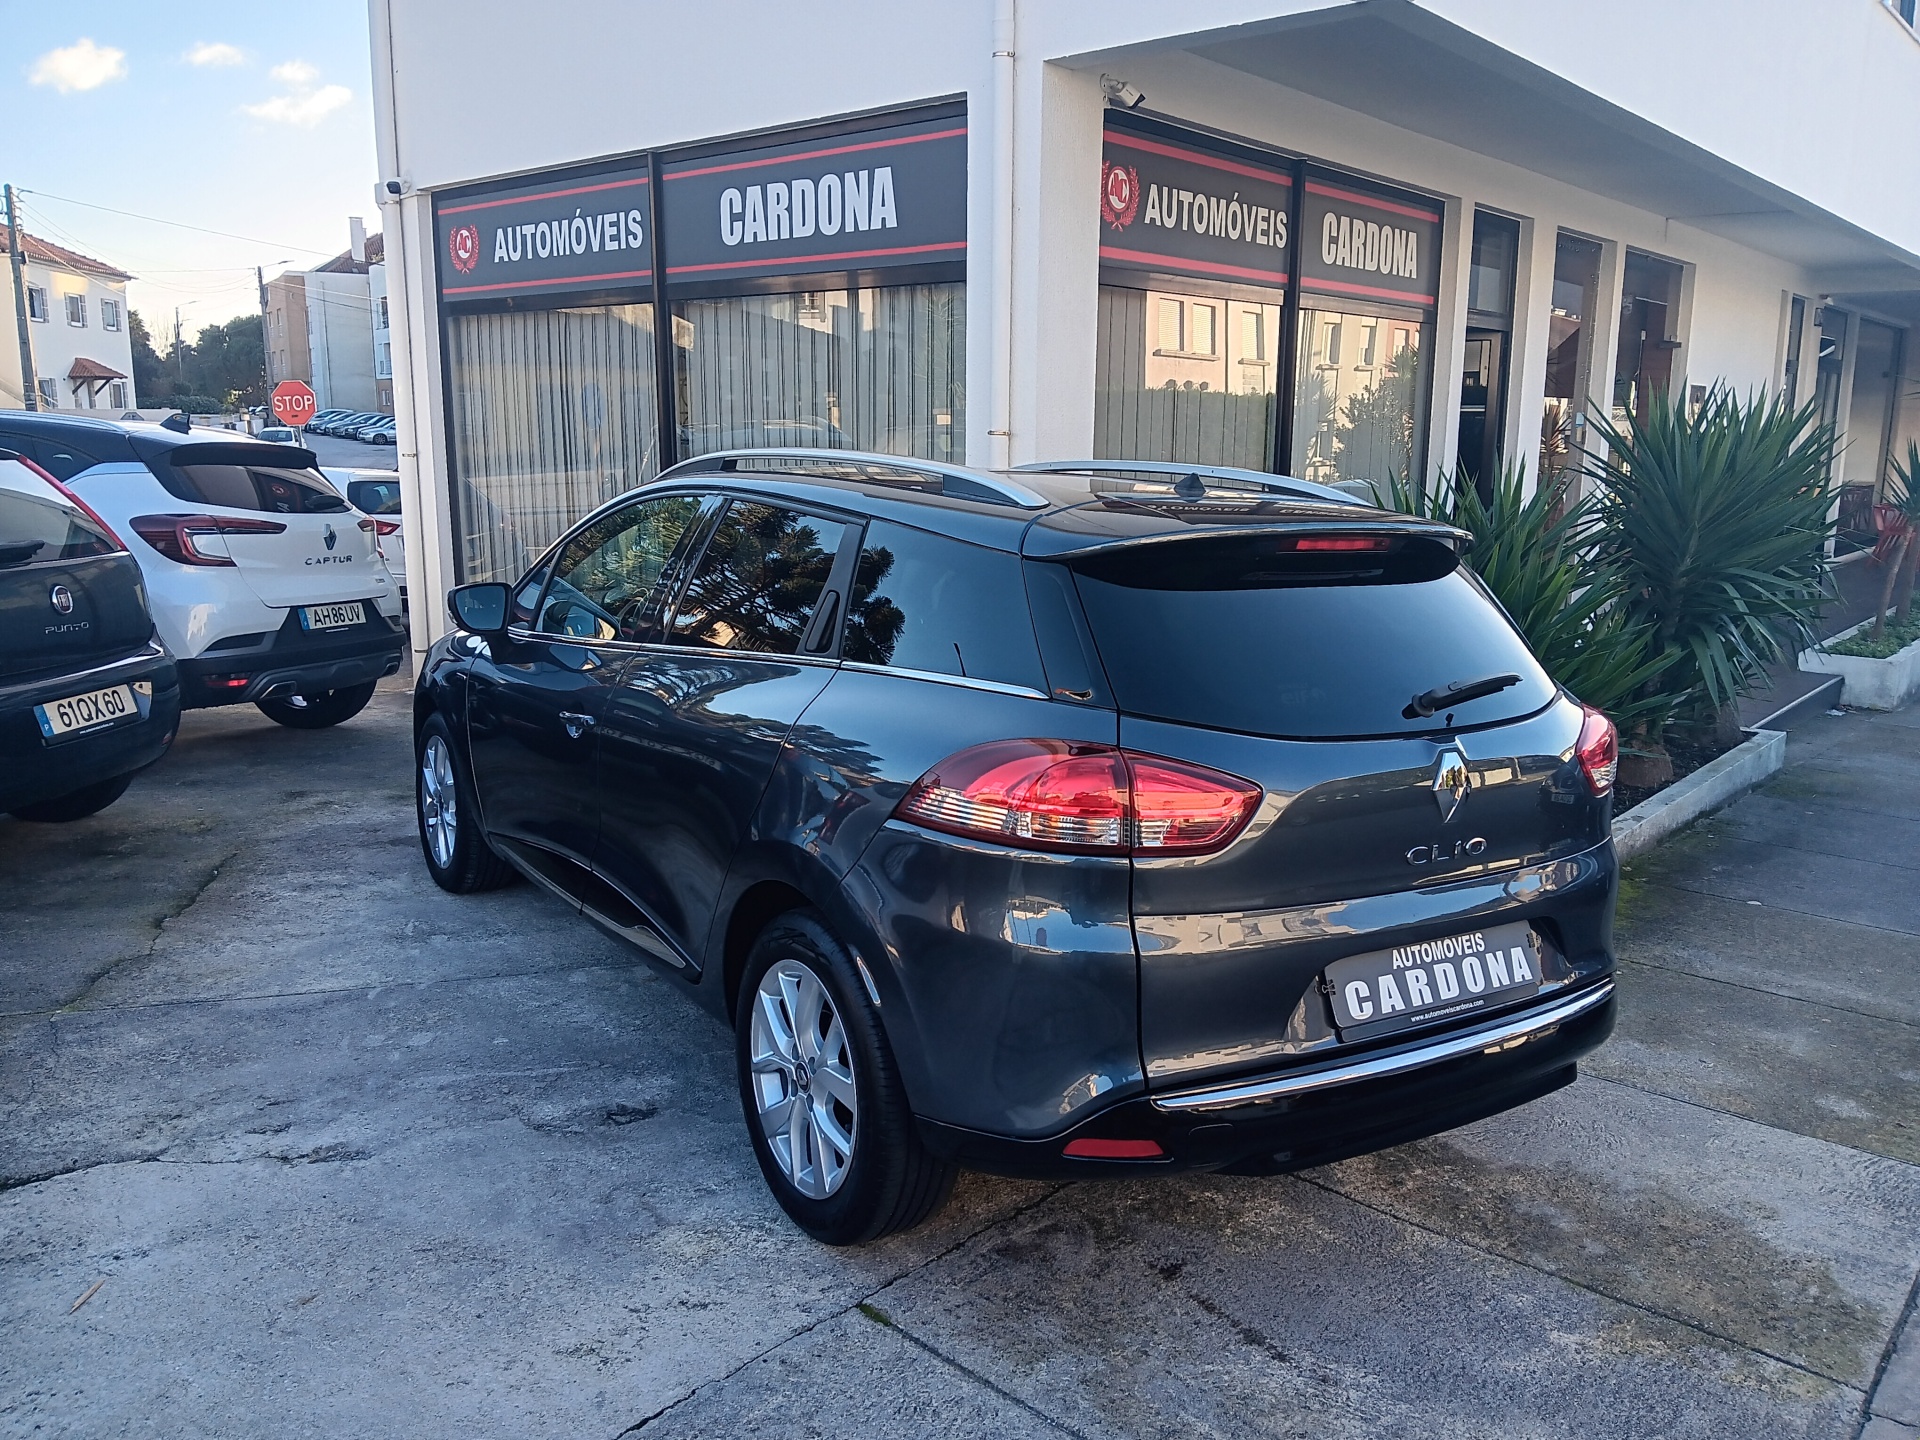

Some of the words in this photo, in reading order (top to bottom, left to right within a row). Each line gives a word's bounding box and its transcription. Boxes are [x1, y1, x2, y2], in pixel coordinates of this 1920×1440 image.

[494, 208, 643, 263] AUTOMÓVEIS
[720, 166, 898, 246] CARDONA
[1144, 183, 1288, 249] AUTOMÓVEIS
[1322, 212, 1417, 279] CARDONA
[274, 395, 313, 412] STOP
[305, 555, 352, 566] CAPTUR
[1405, 837, 1488, 866] CLIO
[1344, 946, 1533, 1020] CARDONA
